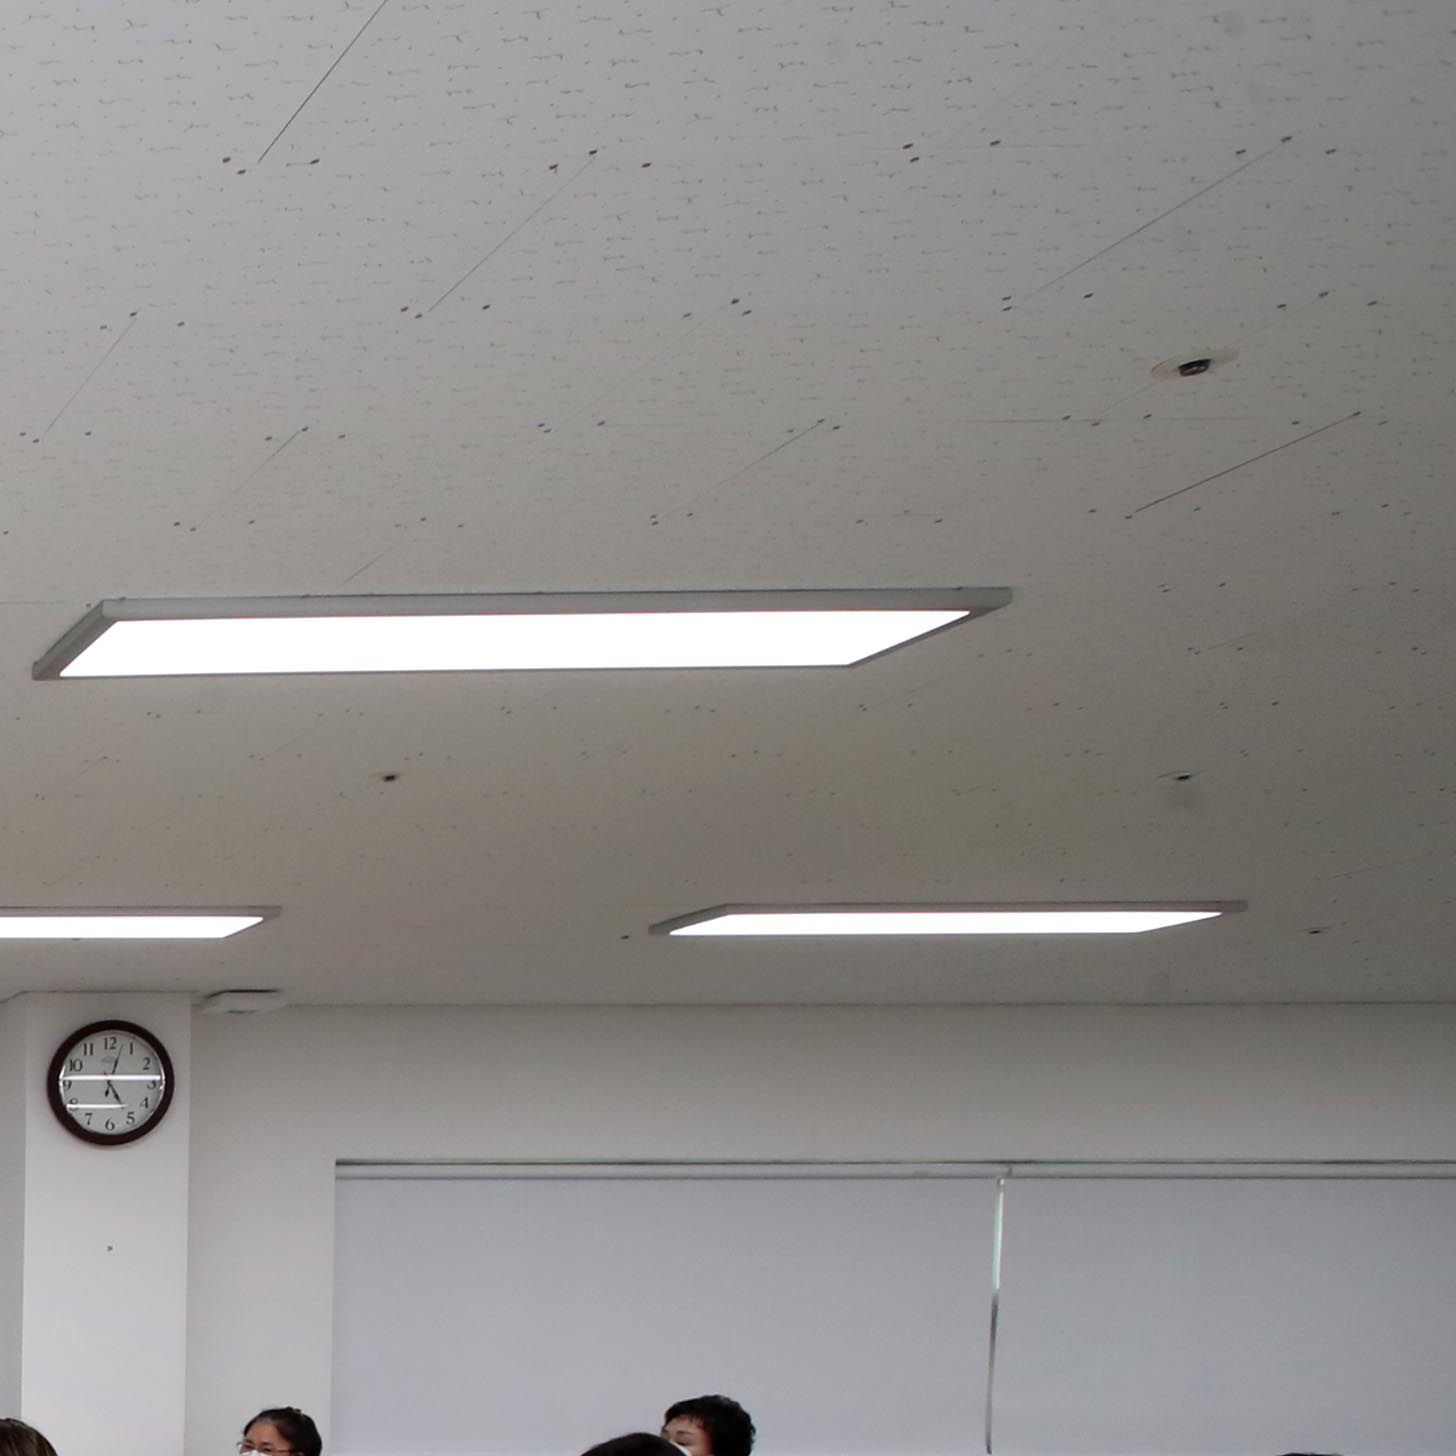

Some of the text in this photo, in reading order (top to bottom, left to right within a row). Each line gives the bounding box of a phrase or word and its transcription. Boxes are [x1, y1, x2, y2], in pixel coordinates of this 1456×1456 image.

[83, 1043, 94, 1056] 11
[103, 1036, 117, 1050] 12
[69, 1058, 83, 1072] 10
[142, 1057, 151, 1071] 2
[83, 1112, 93, 1126] 7
[104, 1118, 115, 1131] 6
[125, 1111, 136, 1125] 5
